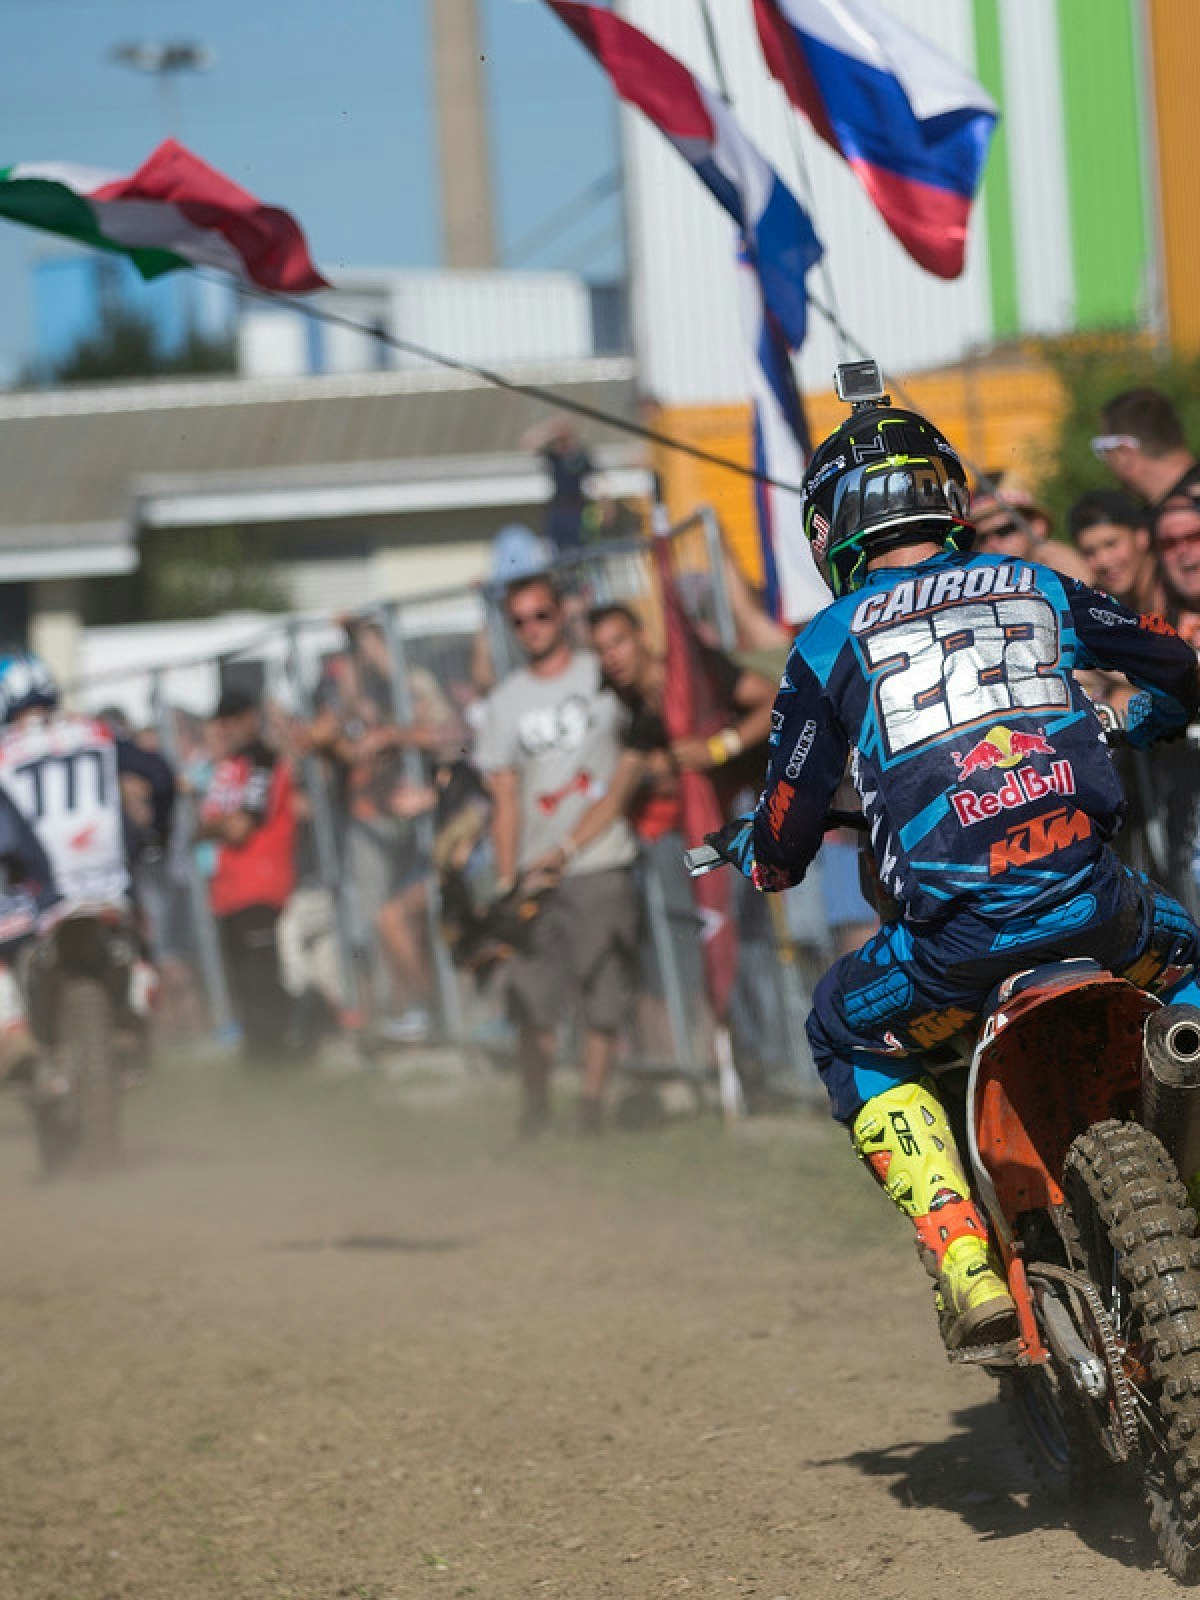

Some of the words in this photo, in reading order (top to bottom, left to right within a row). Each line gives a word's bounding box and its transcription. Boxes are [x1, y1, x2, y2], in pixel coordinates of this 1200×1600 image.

[851, 565, 1037, 634] CAIROLI
[865, 599, 1069, 754] 222
[950, 769, 1026, 828] Red
[1018, 759, 1076, 803] Bull
[989, 807, 1092, 877] KTM
